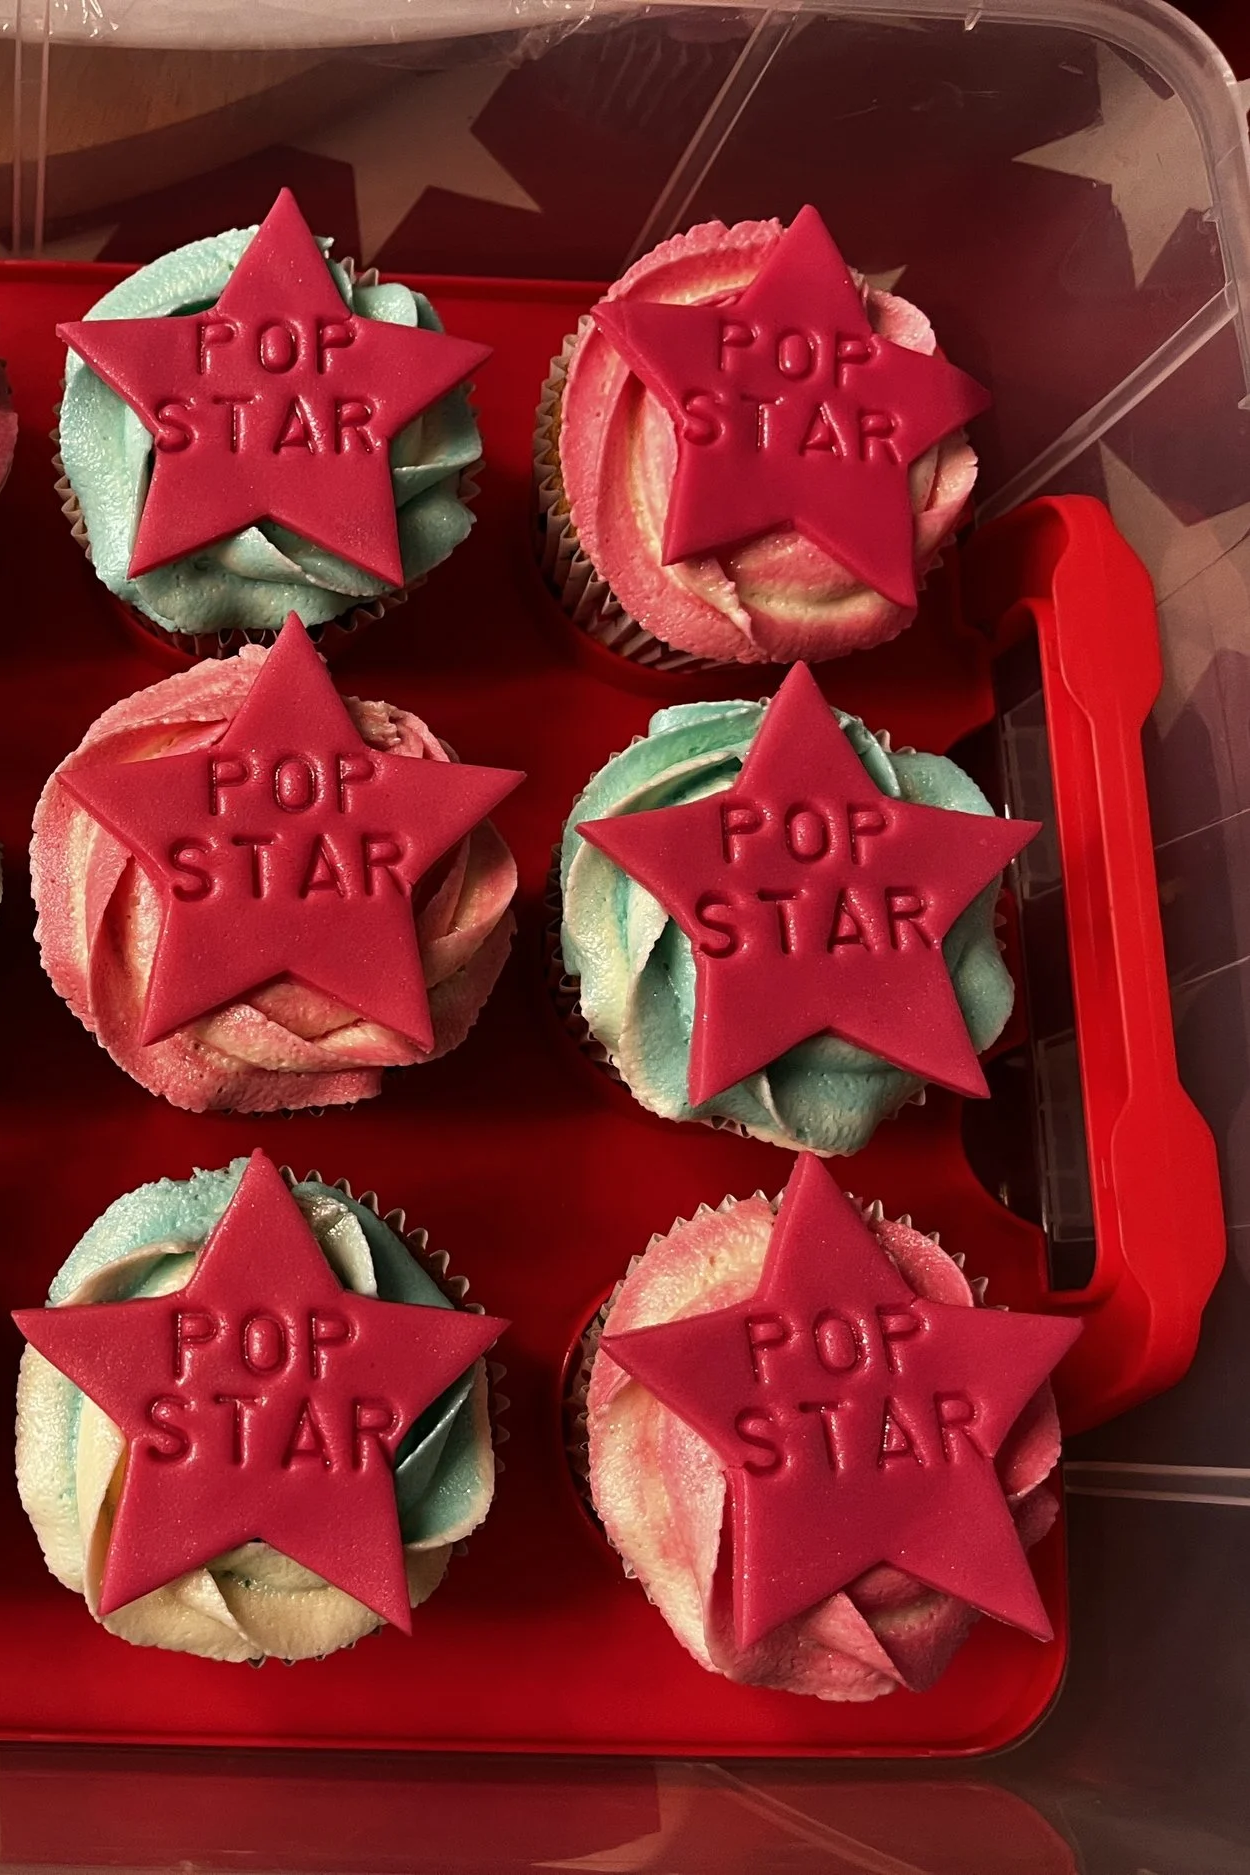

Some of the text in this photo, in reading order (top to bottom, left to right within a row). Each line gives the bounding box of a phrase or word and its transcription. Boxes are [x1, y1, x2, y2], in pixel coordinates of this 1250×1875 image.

[200, 321, 355, 374] POP
[720, 324, 871, 384] POP
[155, 394, 380, 455] STAR
[683, 394, 904, 462] STAR
[211, 754, 376, 814] POP
[172, 835, 408, 901] STAR
[726, 806, 886, 865] POP
[699, 890, 936, 959] STAR
[175, 1309, 354, 1381] POP
[749, 1306, 929, 1382] POP
[145, 1397, 405, 1470] STAR
[739, 1393, 975, 1470] STAR
